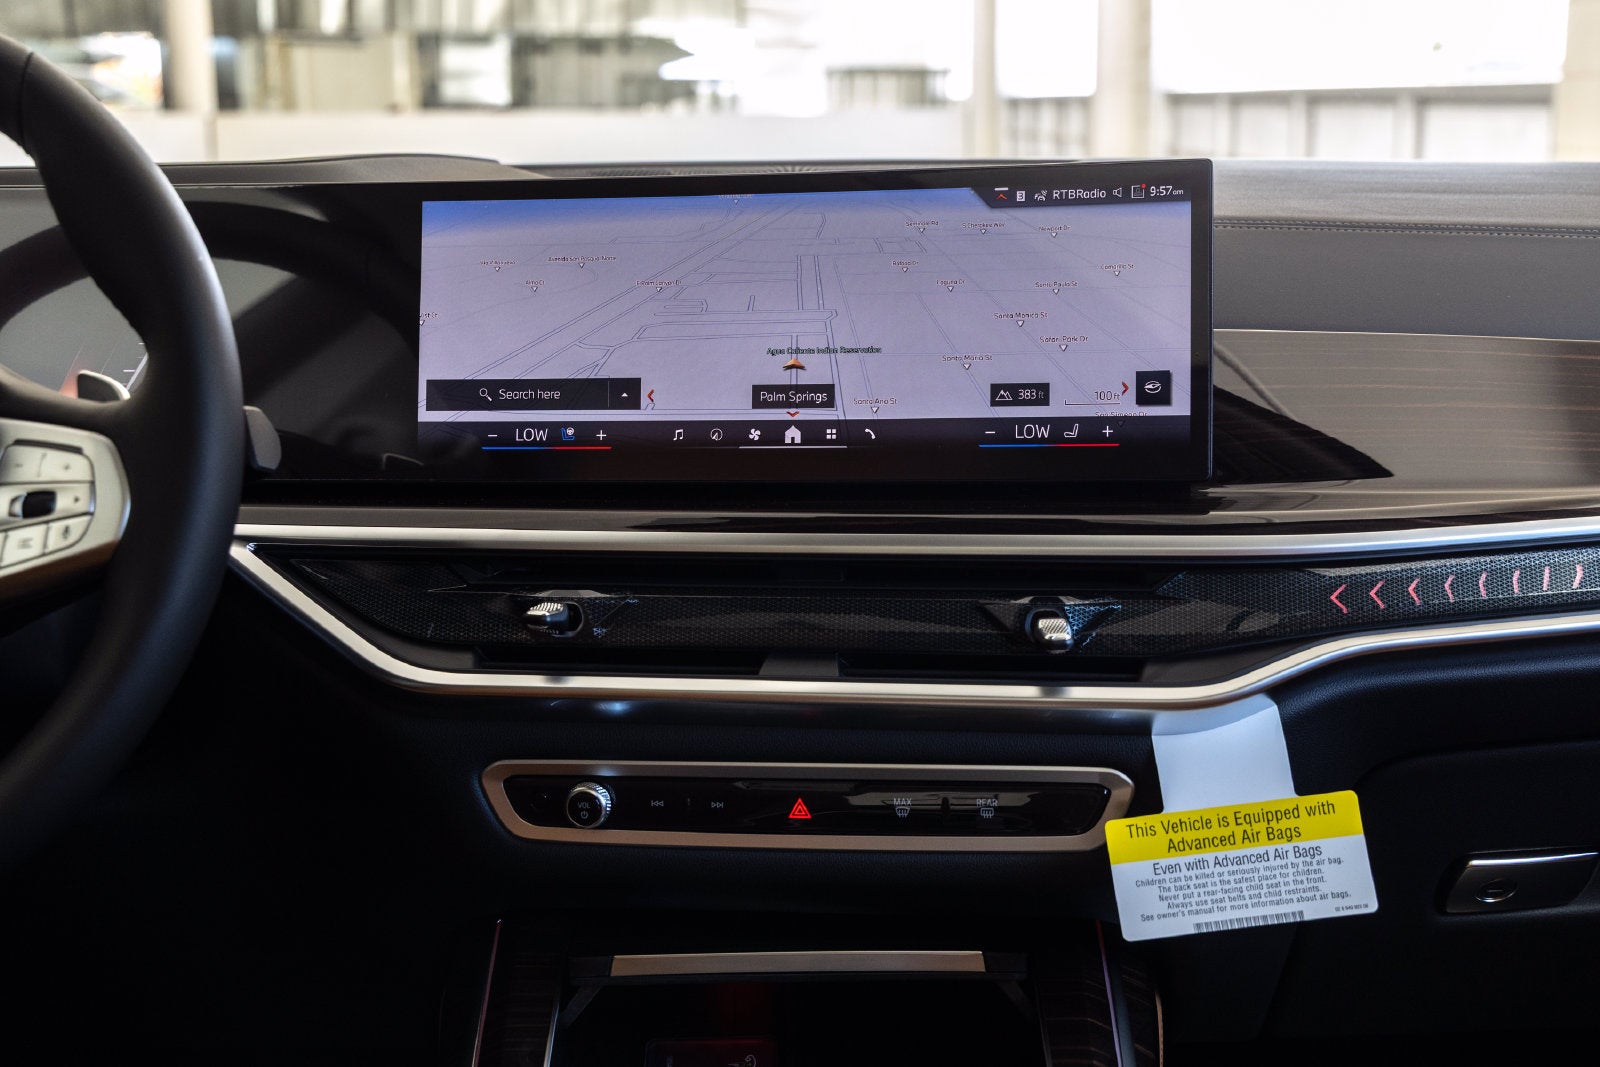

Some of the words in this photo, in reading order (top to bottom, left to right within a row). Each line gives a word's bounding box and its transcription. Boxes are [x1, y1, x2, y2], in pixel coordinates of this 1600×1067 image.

[1053, 188, 1106, 200] RTBRadio
[767, 348, 785, 356] Agua
[500, 388, 534, 400] Search
[538, 388, 560, 400] here
[760, 392, 786, 402] Palm
[788, 391, 828, 404] Springs
[1018, 390, 1036, 400] 383
[1038, 390, 1044, 399] ft
[1094, 390, 1112, 400] 100
[516, 428, 548, 442] LOW
[1015, 425, 1050, 439] LOW
[894, 798, 912, 806] MAX
[976, 798, 998, 806] REAR
[1126, 824, 1156, 839] This
[1161, 815, 1212, 835] Vehicle
[1217, 814, 1230, 828] is
[1234, 804, 1300, 828] Equipped
[1305, 800, 1336, 817] with
[1167, 832, 1236, 854] Advanced
[1241, 829, 1260, 845] Air
[1266, 826, 1302, 843] Bags
[1152, 862, 1182, 876] Even
[1184, 857, 1210, 872] with
[1213, 849, 1270, 868] Advanced
[1273, 848, 1290, 861] Air
[1293, 845, 1322, 860] Bags
[1136, 879, 1167, 888] Children
[1168, 876, 1183, 884] can
[1184, 874, 1194, 882] be
[1194, 870, 1214, 880] killed
[1227, 865, 1260, 876] seriously
[1263, 862, 1288, 873] injured
[1291, 861, 1300, 870] by
[1302, 859, 1314, 867] the
[1316, 858, 1325, 866] air
[1328, 856, 1344, 865] bag.
[1158, 885, 1172, 894] The
[1174, 882, 1192, 892] back
[1193, 881, 1208, 890] seat
[1220, 877, 1232, 886] the
[1234, 875, 1259, 885] safest
[1258, 874, 1278, 883] place
[1279, 870, 1290, 878] for
[1292, 868, 1324, 878] children.
[1158, 894, 1180, 902] Never
[1182, 891, 1194, 900] put
[1204, 885, 1244, 897] rear-facing
[1246, 883, 1264, 892] child
[1266, 881, 1281, 889] seat
[1292, 878, 1304, 886] the
[1306, 876, 1326, 884] front.
[1167, 901, 1193, 910] Always
[1210, 896, 1226, 905] seat
[1228, 893, 1246, 903] belts
[1248, 892, 1262, 900] and
[1264, 890, 1282, 898] child
[1284, 885, 1322, 895] restraints.
[1140, 914, 1154, 922] See
[1156, 910, 1186, 920] owner's
[1188, 906, 1214, 916] manual
[1217, 904, 1227, 912] for
[1230, 903, 1249, 911] more
[1251, 897, 1294, 908] information
[1296, 894, 1318, 903] about
[1320, 892, 1328, 900] air
[1331, 890, 1352, 900] bags.
